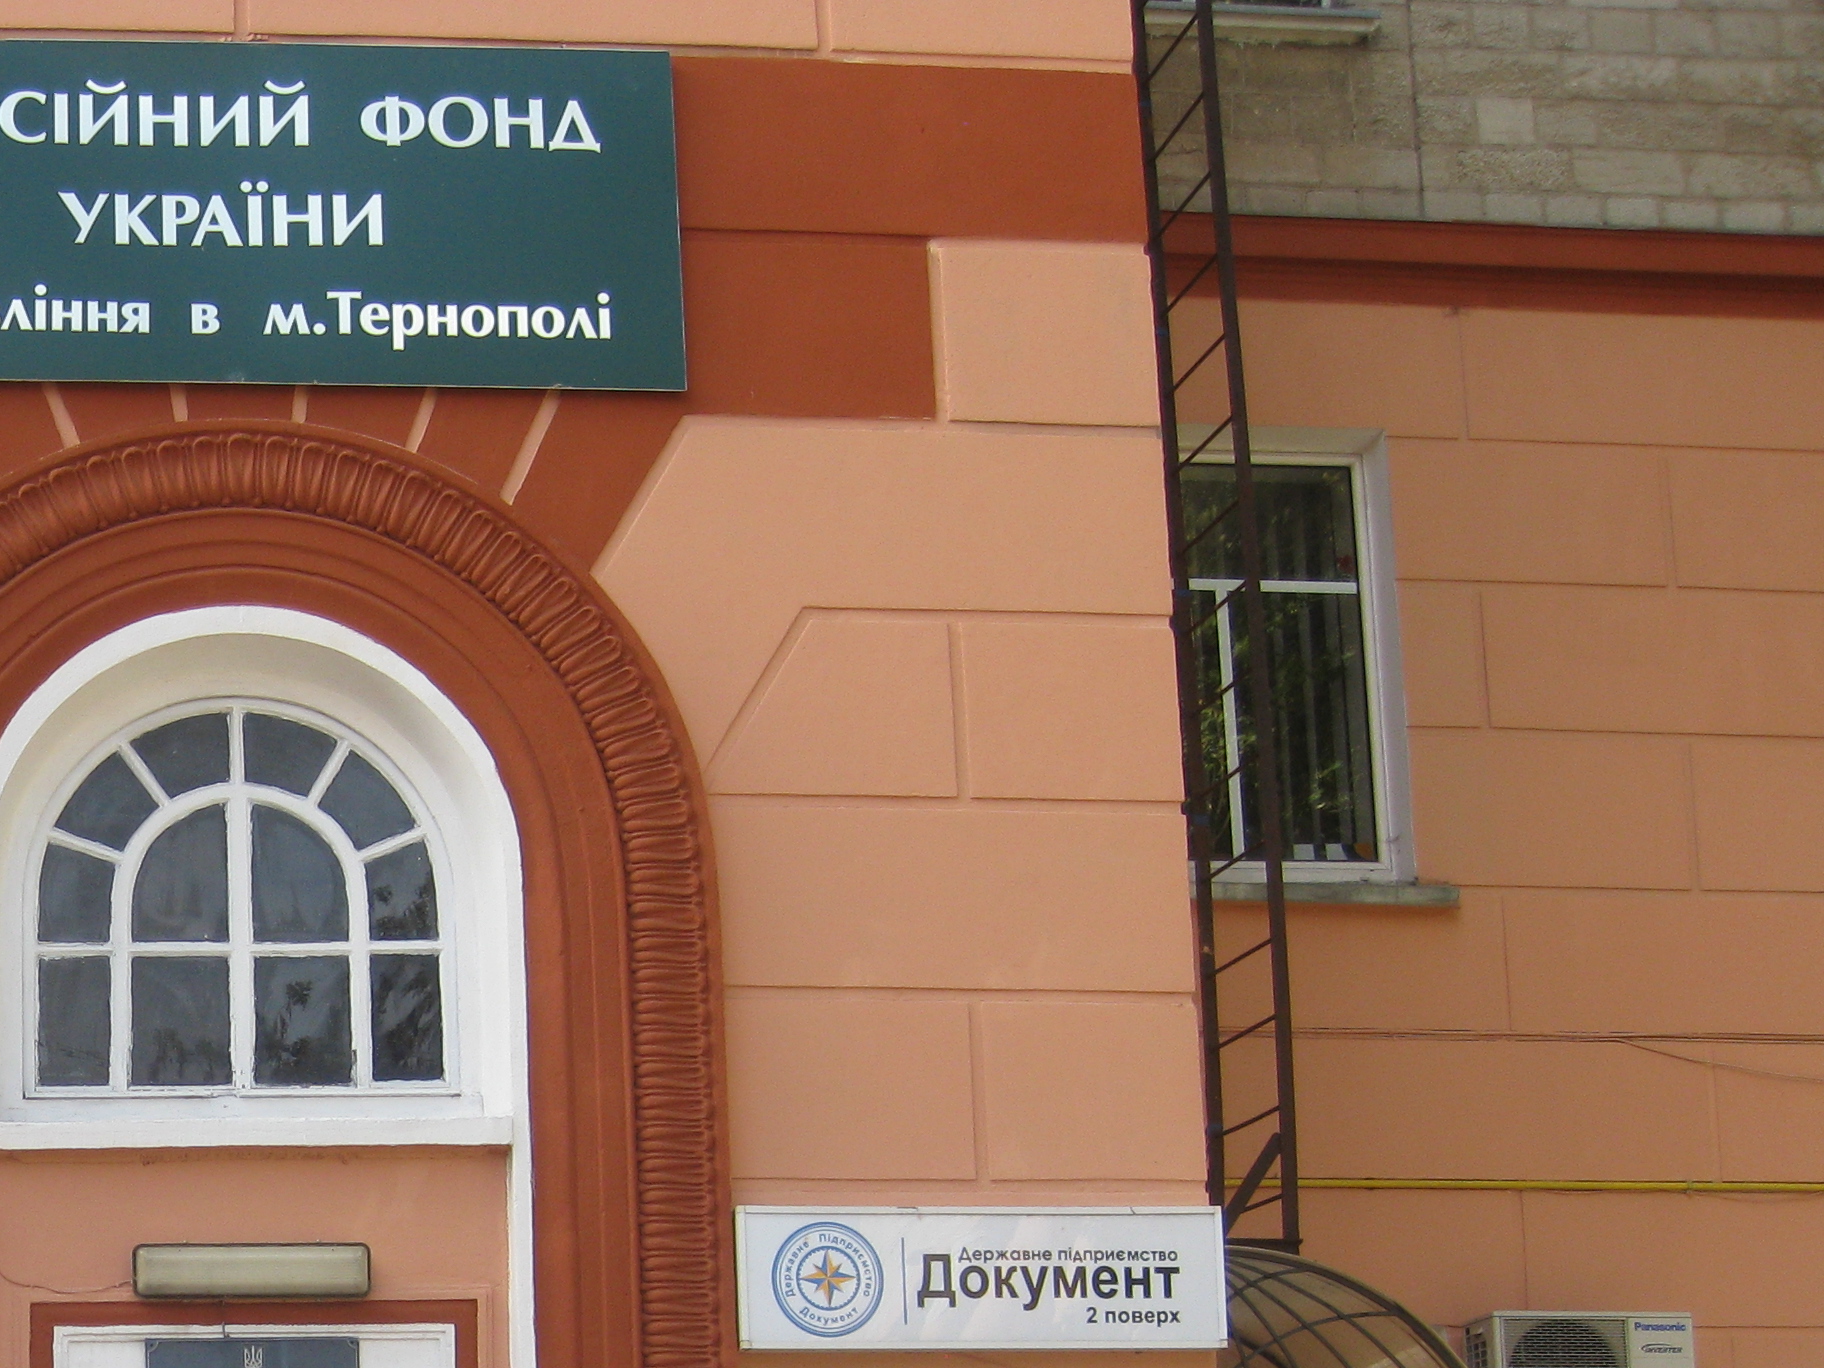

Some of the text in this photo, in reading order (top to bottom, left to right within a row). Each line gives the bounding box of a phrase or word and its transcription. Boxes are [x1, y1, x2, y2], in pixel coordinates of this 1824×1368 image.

[360, 93, 601, 153] ФОНД
[57, 179, 384, 246] УКРАЇНИ
[191, 303, 220, 335] в
[263, 289, 612, 349] м.Тернополі
[918, 1255, 1180, 1309] Документ
[959, 1247, 1178, 1263] Державне підприємство
[1086, 1309, 1180, 1328] 2 поверх
[1634, 1322, 1686, 1331] Panasonic
